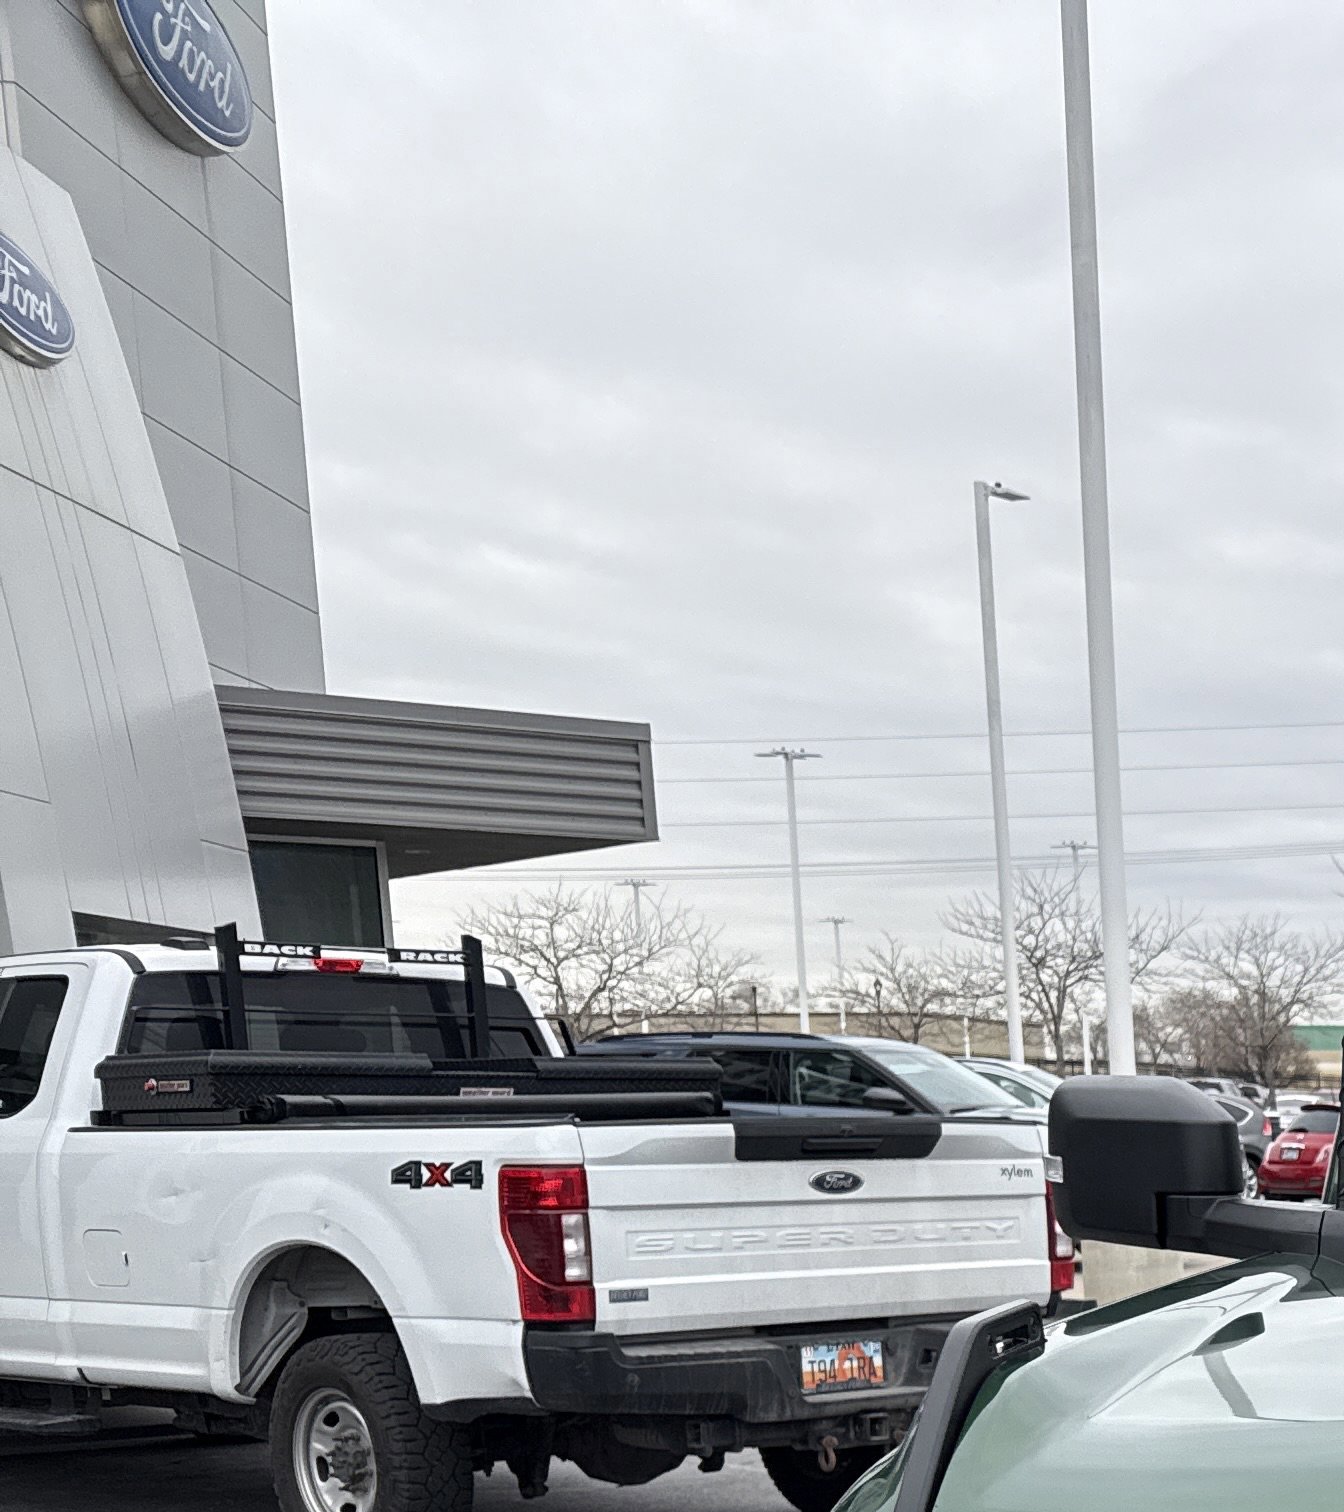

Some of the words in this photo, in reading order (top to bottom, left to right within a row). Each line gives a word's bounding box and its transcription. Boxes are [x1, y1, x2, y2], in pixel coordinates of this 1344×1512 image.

[244, 943, 314, 956] BACK
[400, 951, 466, 963] RACK
[1000, 1164, 1033, 1181] xylem
[635, 1226, 855, 1254] SUPER
[871, 1220, 1015, 1244] DUTY
[808, 1359, 837, 1385] T94
